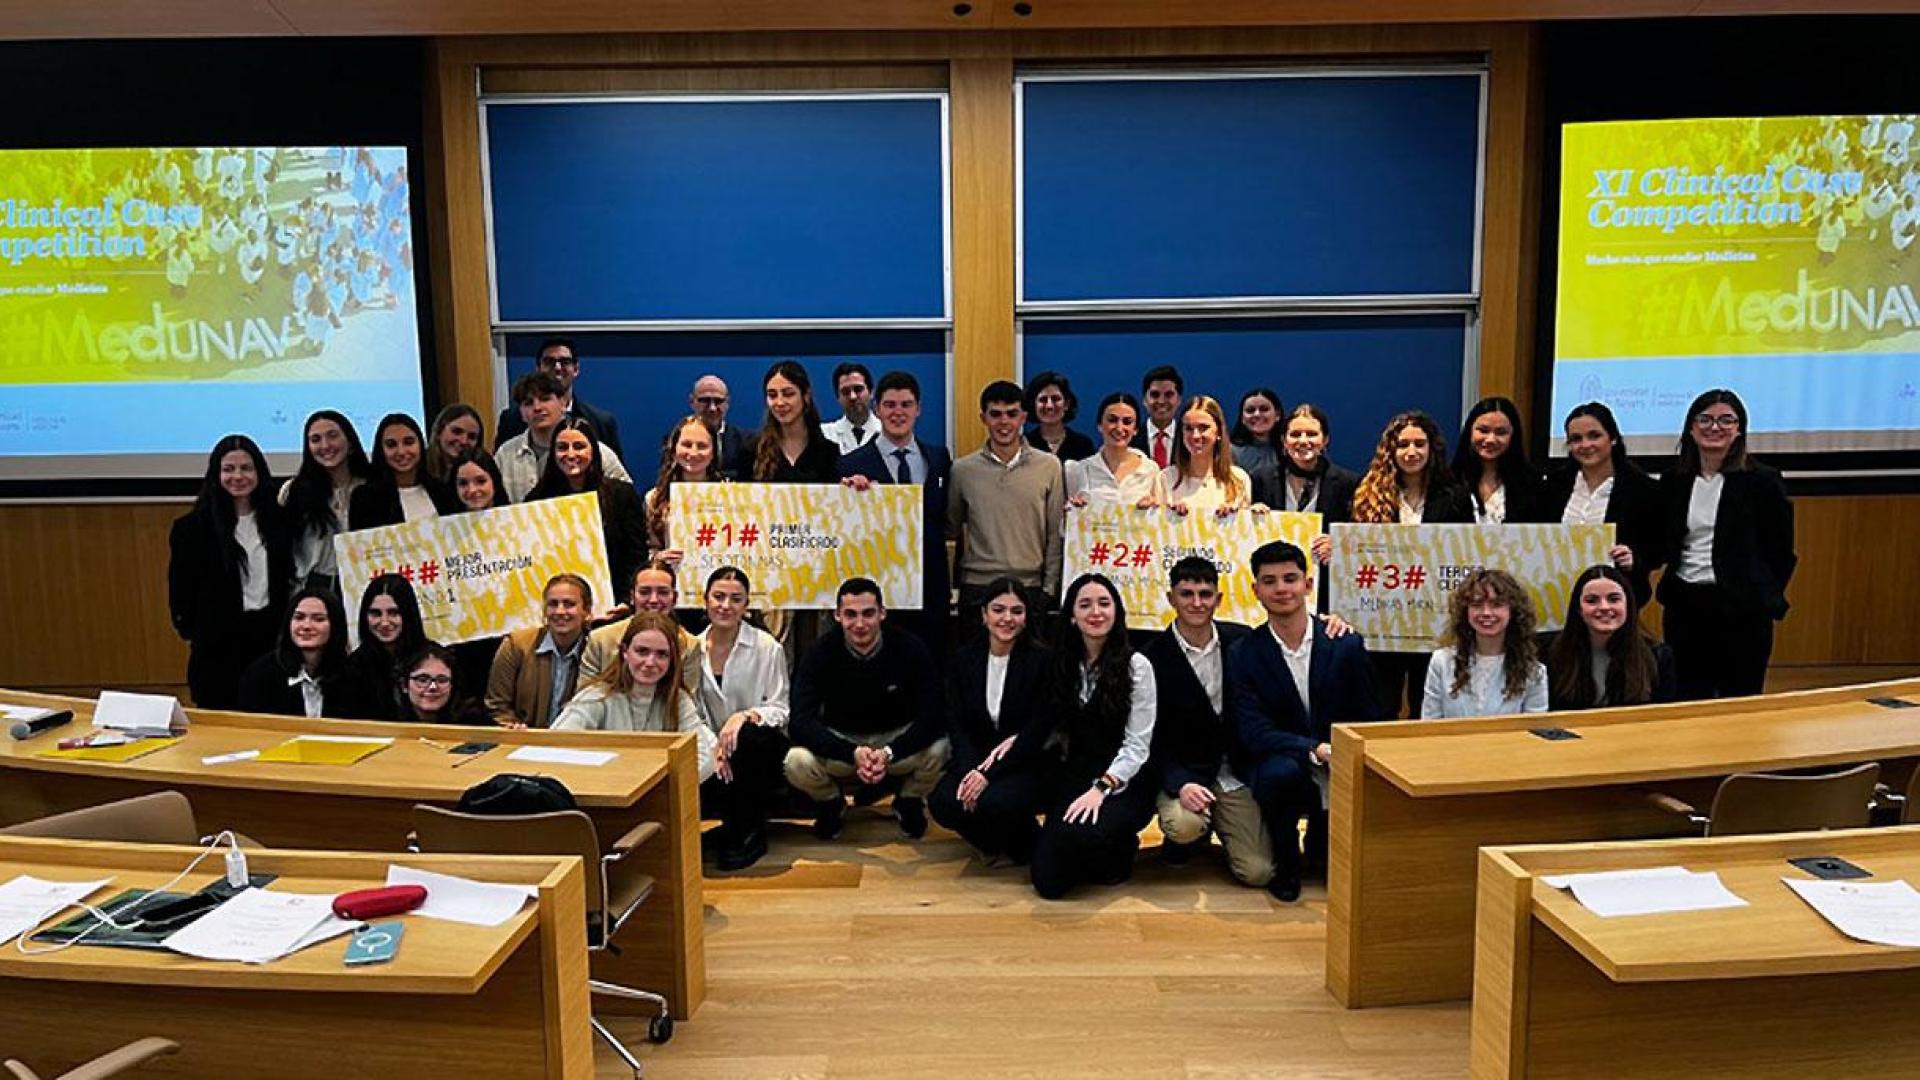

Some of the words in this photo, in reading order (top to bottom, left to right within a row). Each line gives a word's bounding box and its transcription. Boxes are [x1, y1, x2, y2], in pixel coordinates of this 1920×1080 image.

[1586, 169, 1634, 198] XI
[1640, 164, 1775, 196] Clinical
[1782, 164, 1863, 195] Case
[1588, 194, 1801, 233] Competition
[769, 523, 811, 535] PRIMER
[769, 536, 839, 549] CLASIFICADO
[445, 551, 482, 568] MEJOR
